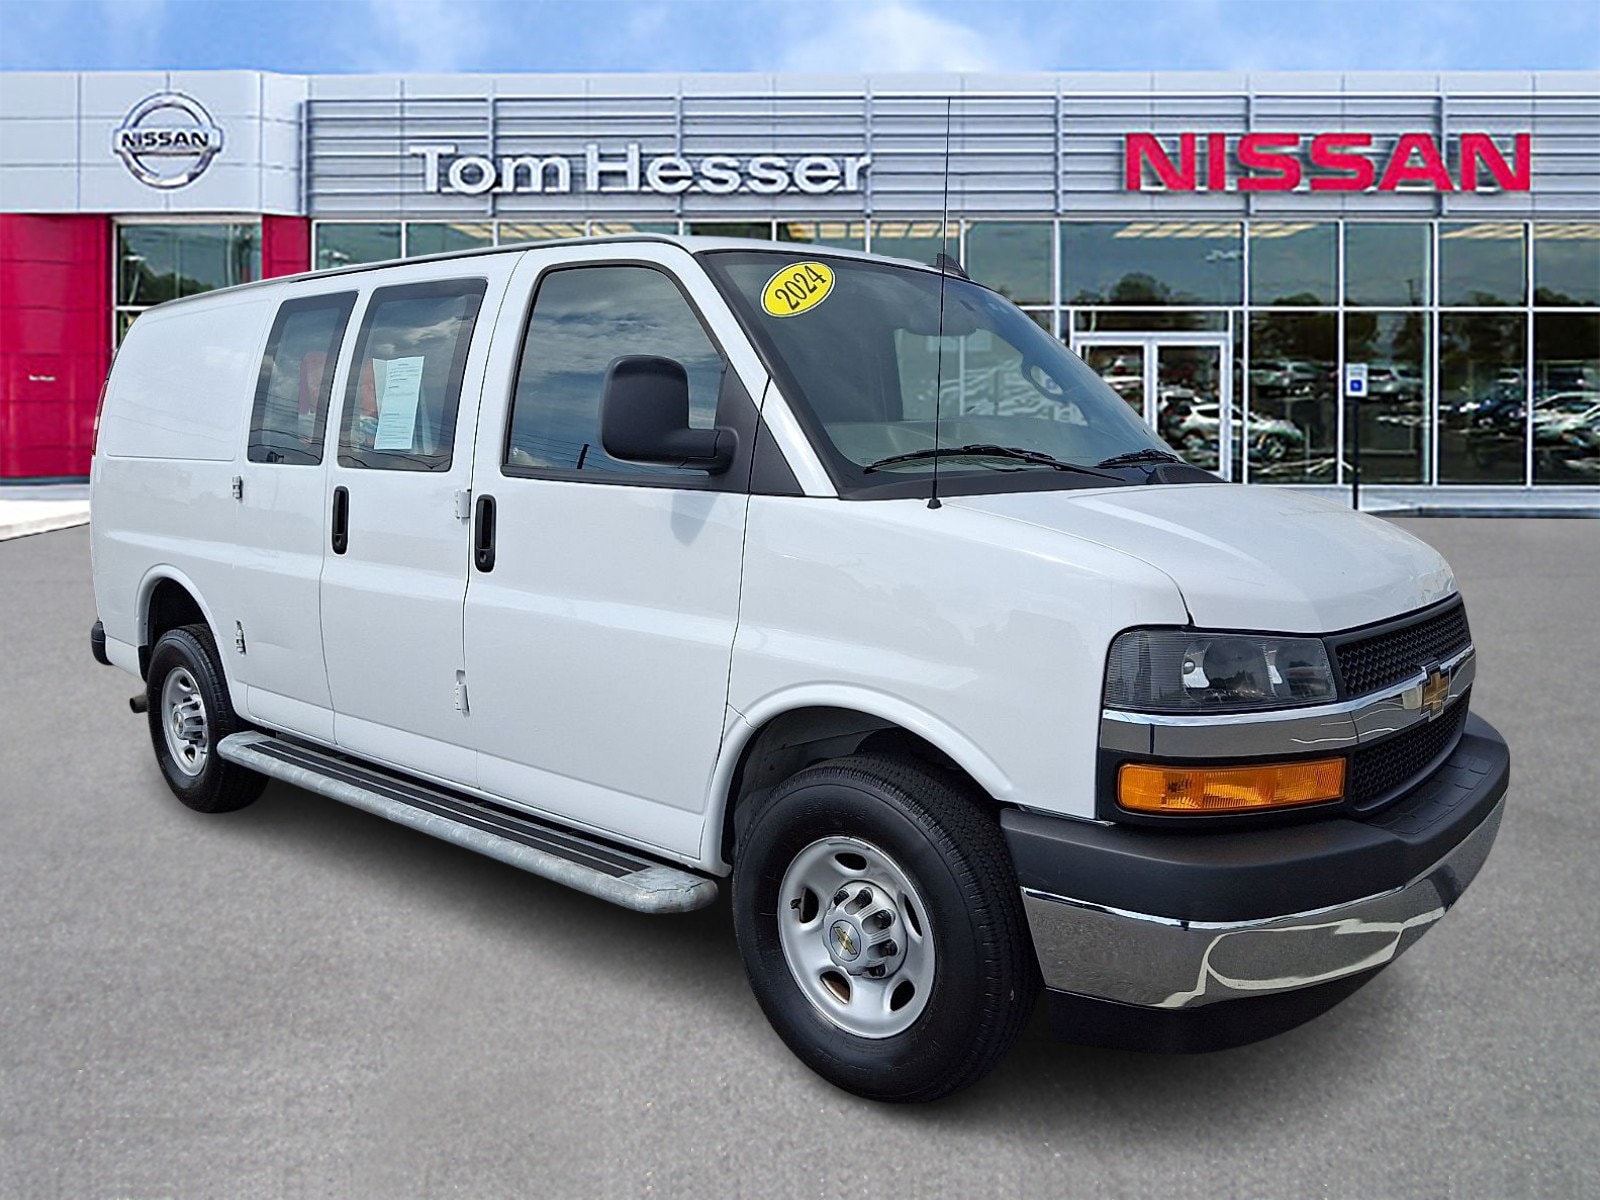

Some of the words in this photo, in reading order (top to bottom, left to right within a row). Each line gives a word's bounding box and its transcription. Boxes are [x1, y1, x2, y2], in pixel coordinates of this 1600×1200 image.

[122, 131, 209, 147] NISSAN
[1125, 132, 1531, 191] NISSAN
[409, 143, 571, 193] Tom
[586, 143, 870, 193] Hesser
[775, 265, 827, 310] 2024
